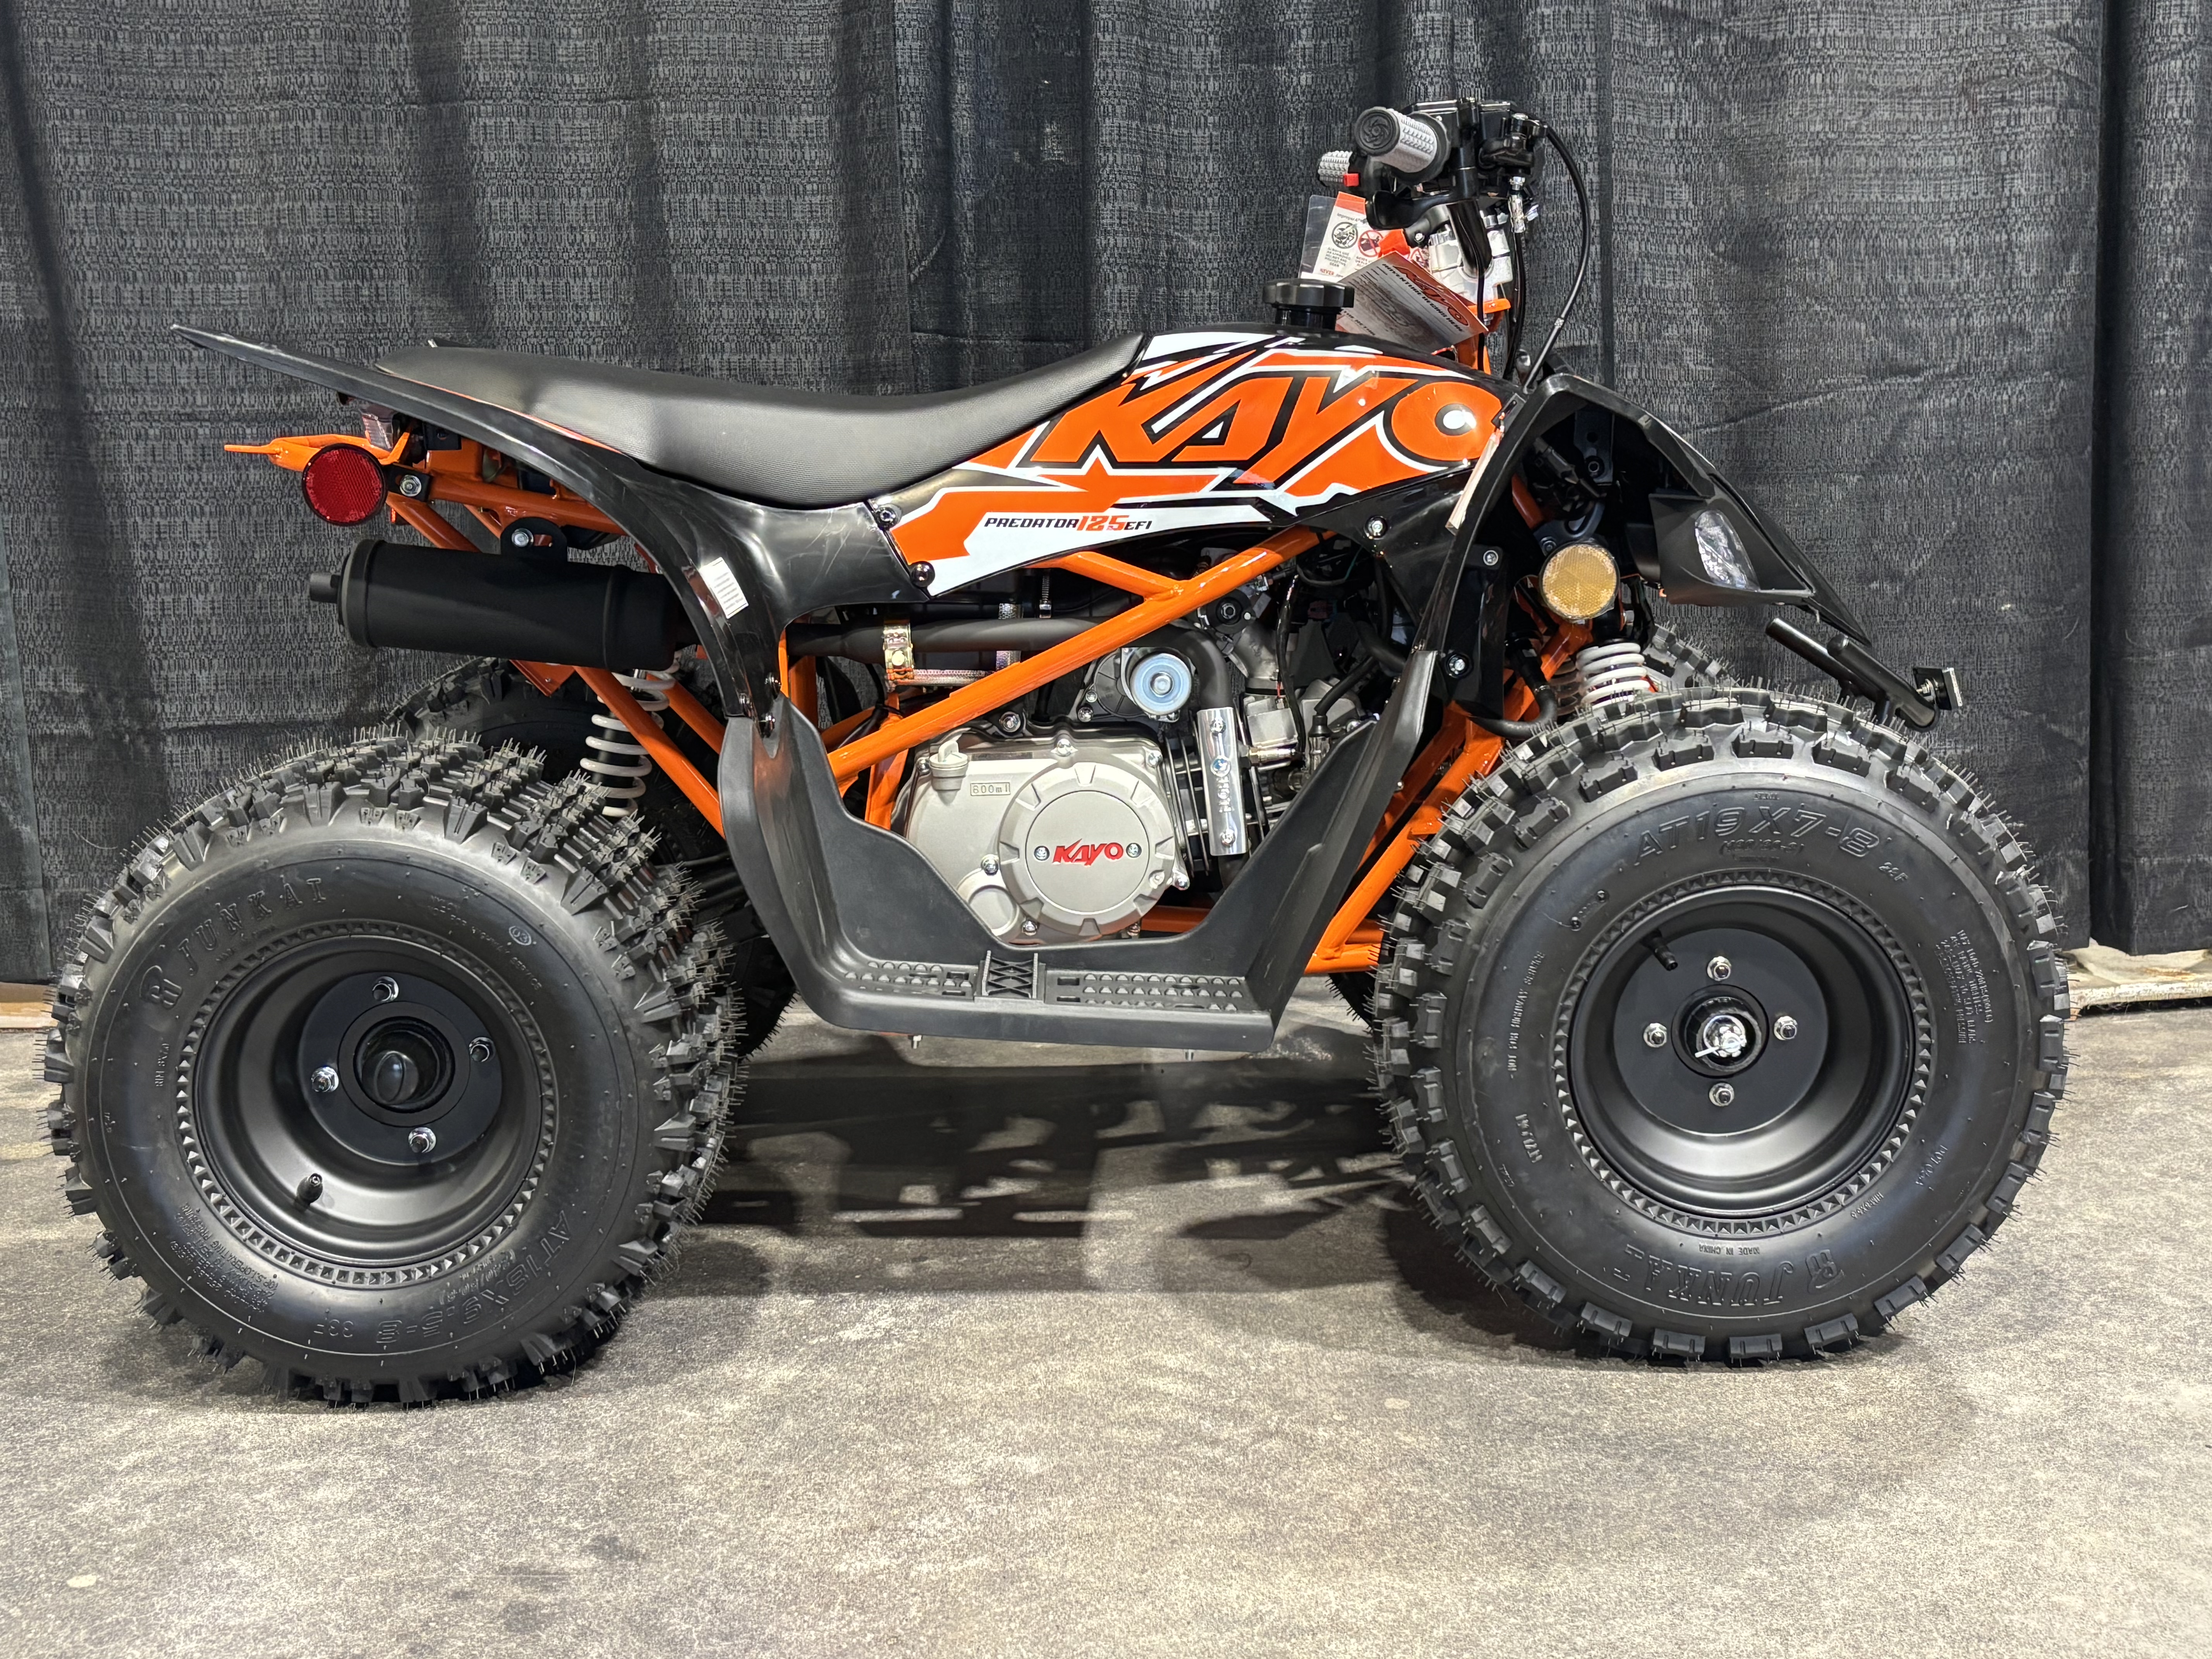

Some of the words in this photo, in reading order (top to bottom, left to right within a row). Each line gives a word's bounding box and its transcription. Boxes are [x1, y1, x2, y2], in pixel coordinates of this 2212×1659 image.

[1030, 349, 1503, 484] KAYO
[1052, 838, 1123, 866] KAYO
[178, 878, 327, 976] JUNKAI
[1697, 1243, 1721, 1254] CHINA
[1726, 1247, 1733, 1255] IN
[1738, 1246, 1760, 1255] MADE
